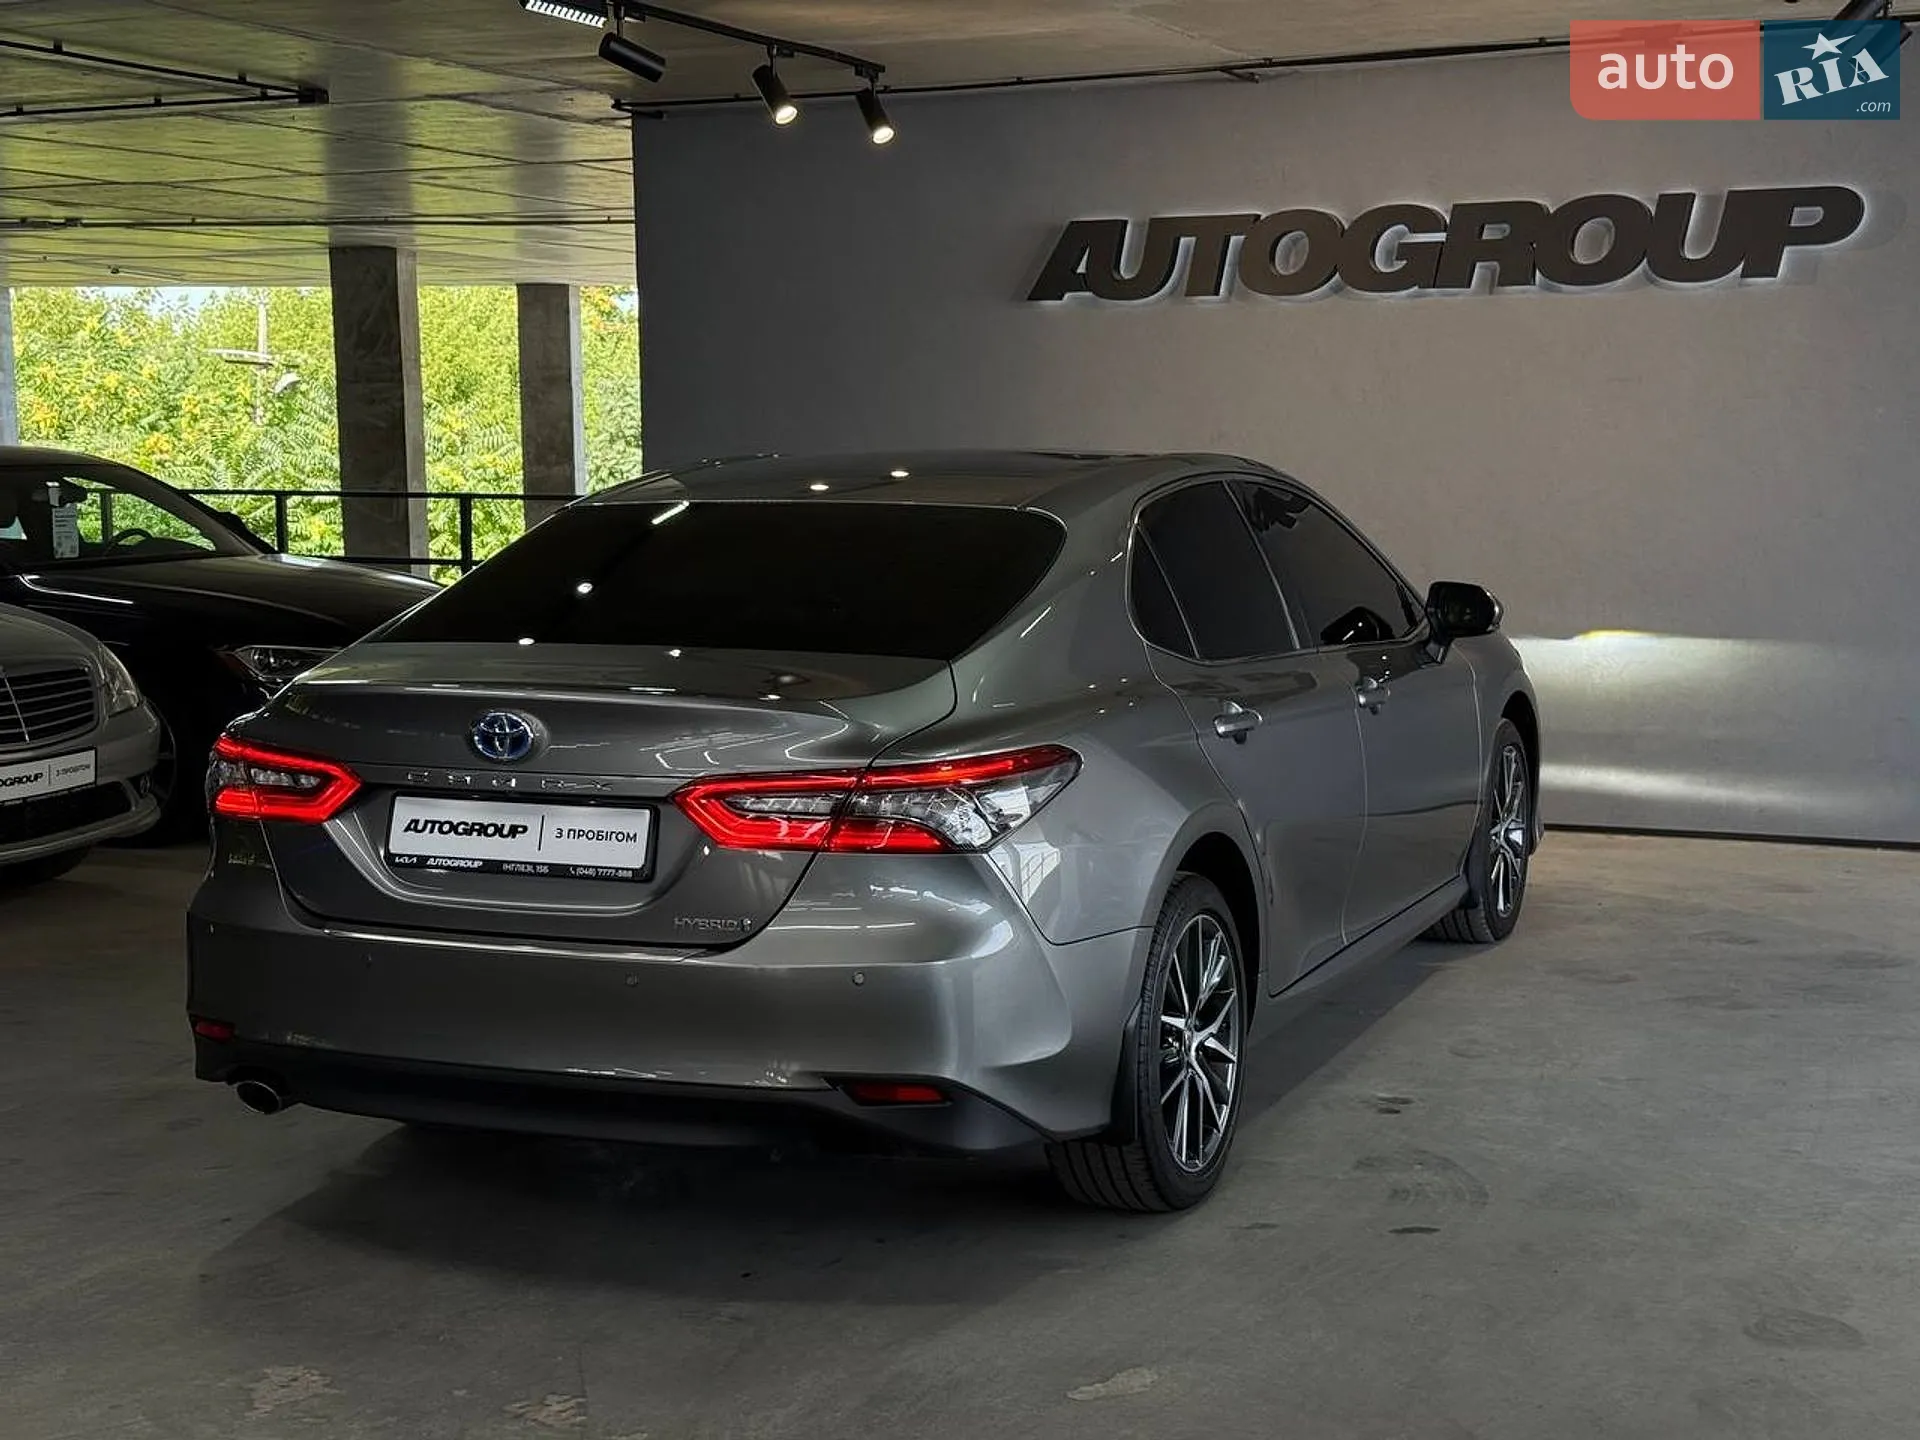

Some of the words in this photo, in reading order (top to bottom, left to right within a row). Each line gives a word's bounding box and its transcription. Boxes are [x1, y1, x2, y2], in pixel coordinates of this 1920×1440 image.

[1027, 185, 1864, 301] AUTOGROUP
[403, 818, 529, 839] AUTOGROUP
[567, 828, 637, 844] ПРОБІГОМ
[426, 857, 483, 869] AUTOGROUP
